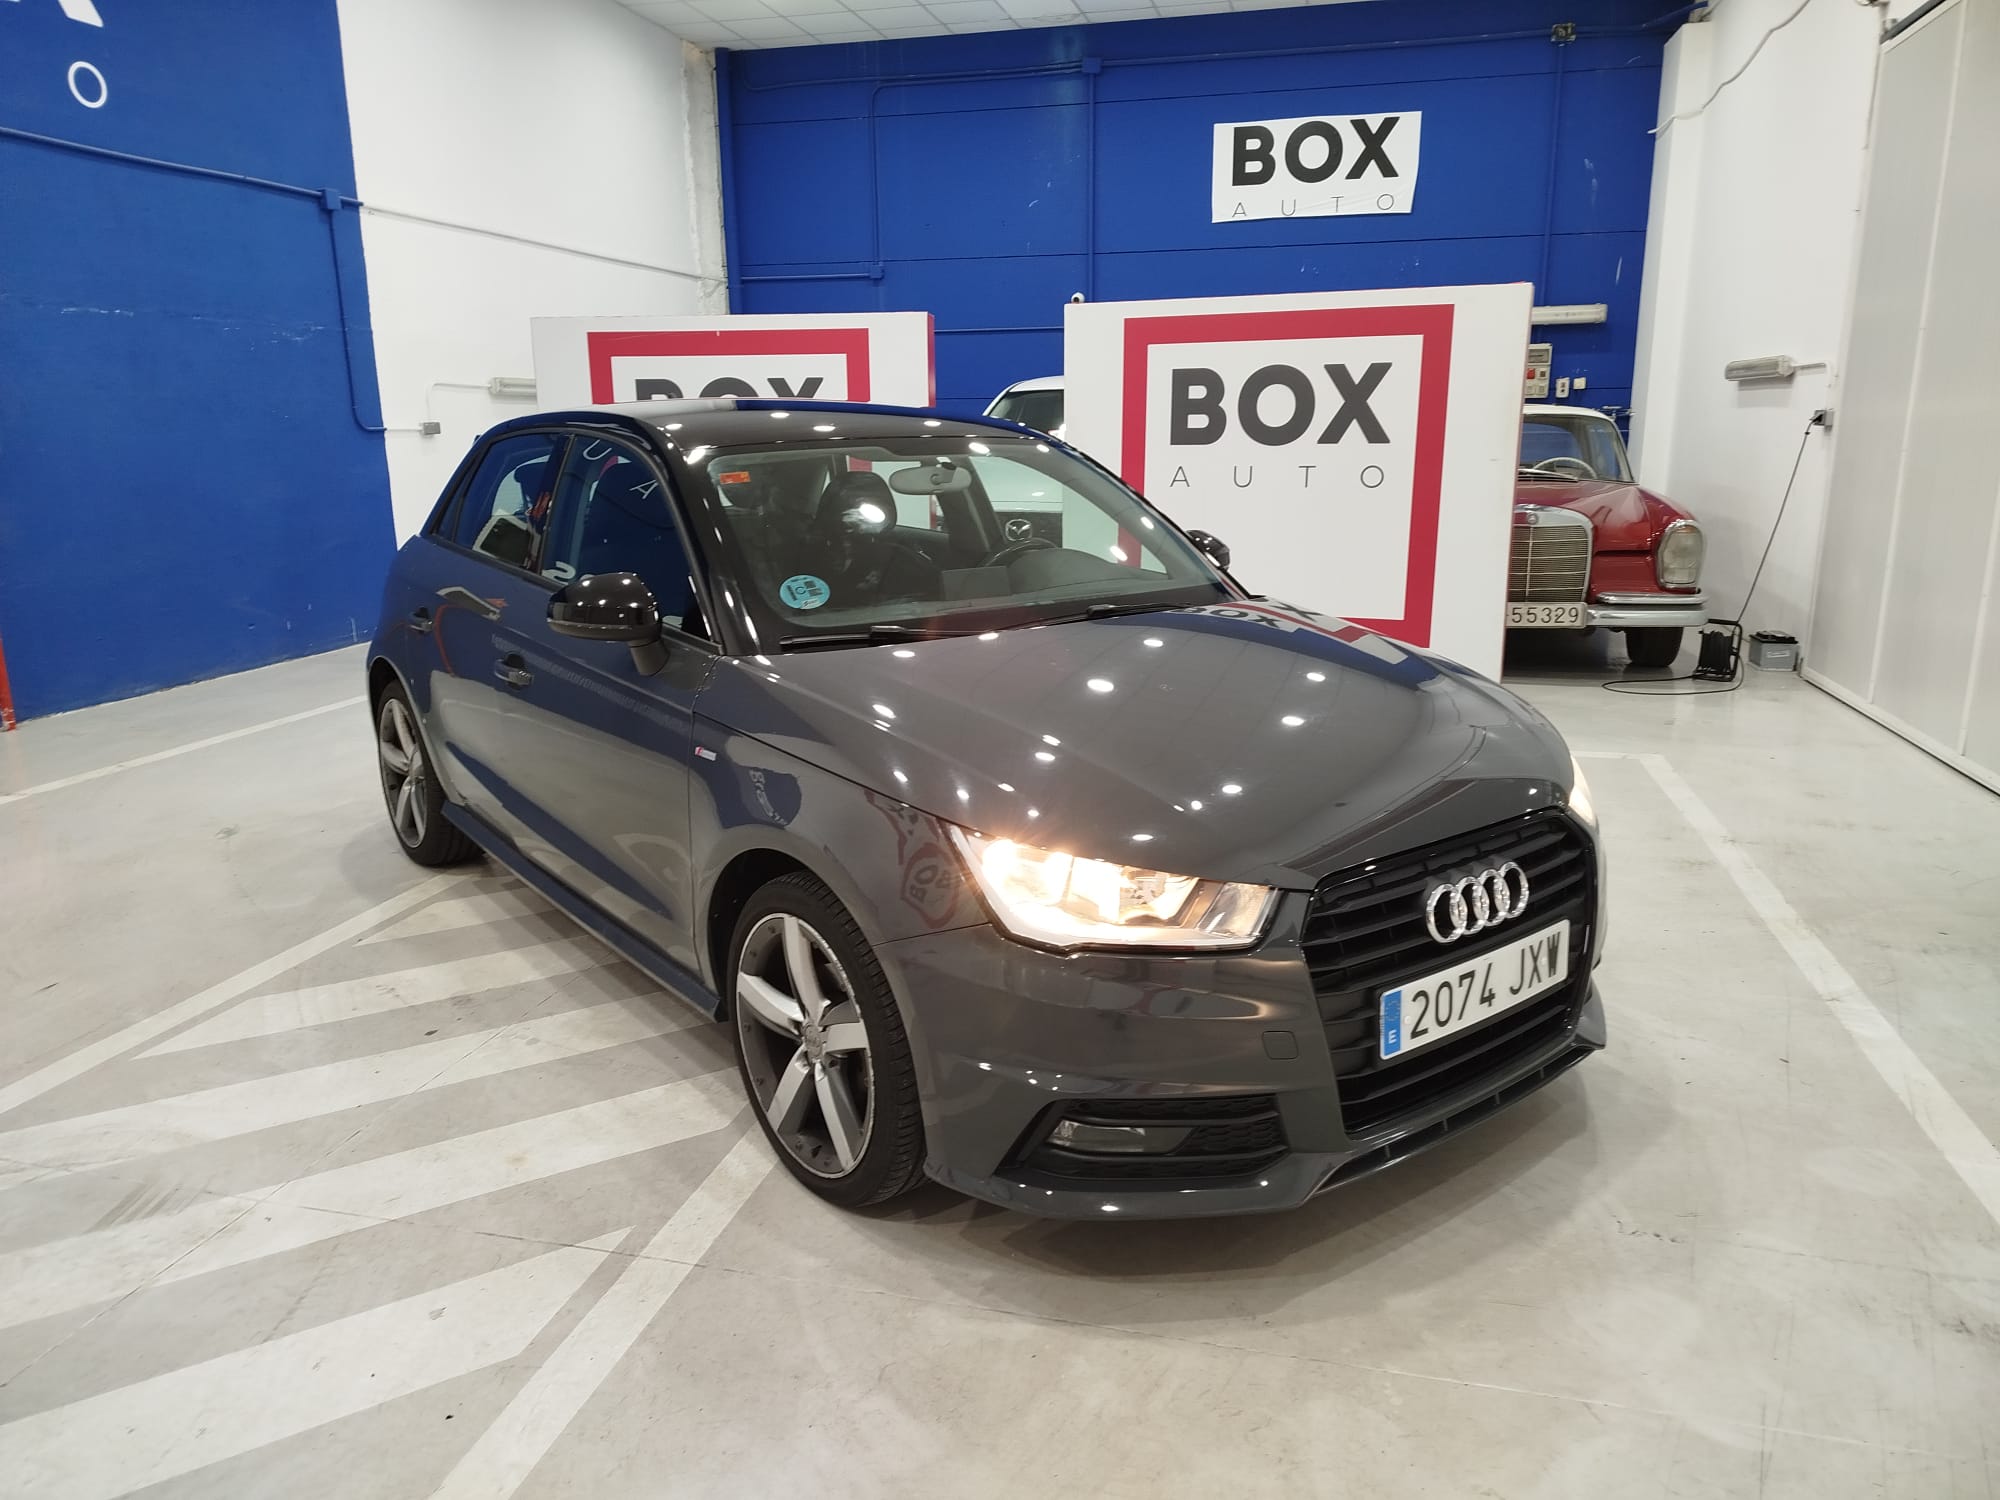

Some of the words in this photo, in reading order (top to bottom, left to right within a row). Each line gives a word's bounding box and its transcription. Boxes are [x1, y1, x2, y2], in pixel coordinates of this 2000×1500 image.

[1232, 116, 1400, 187] BOX
[1232, 193, 1395, 217] AUTO
[1170, 361, 1393, 447] BOX
[1170, 465, 1384, 488] AUTO
[1511, 606, 1579, 623] 55329
[1410, 963, 1495, 1039] 2074
[1509, 931, 1561, 995] JXW
[1388, 1029, 1398, 1044] E
